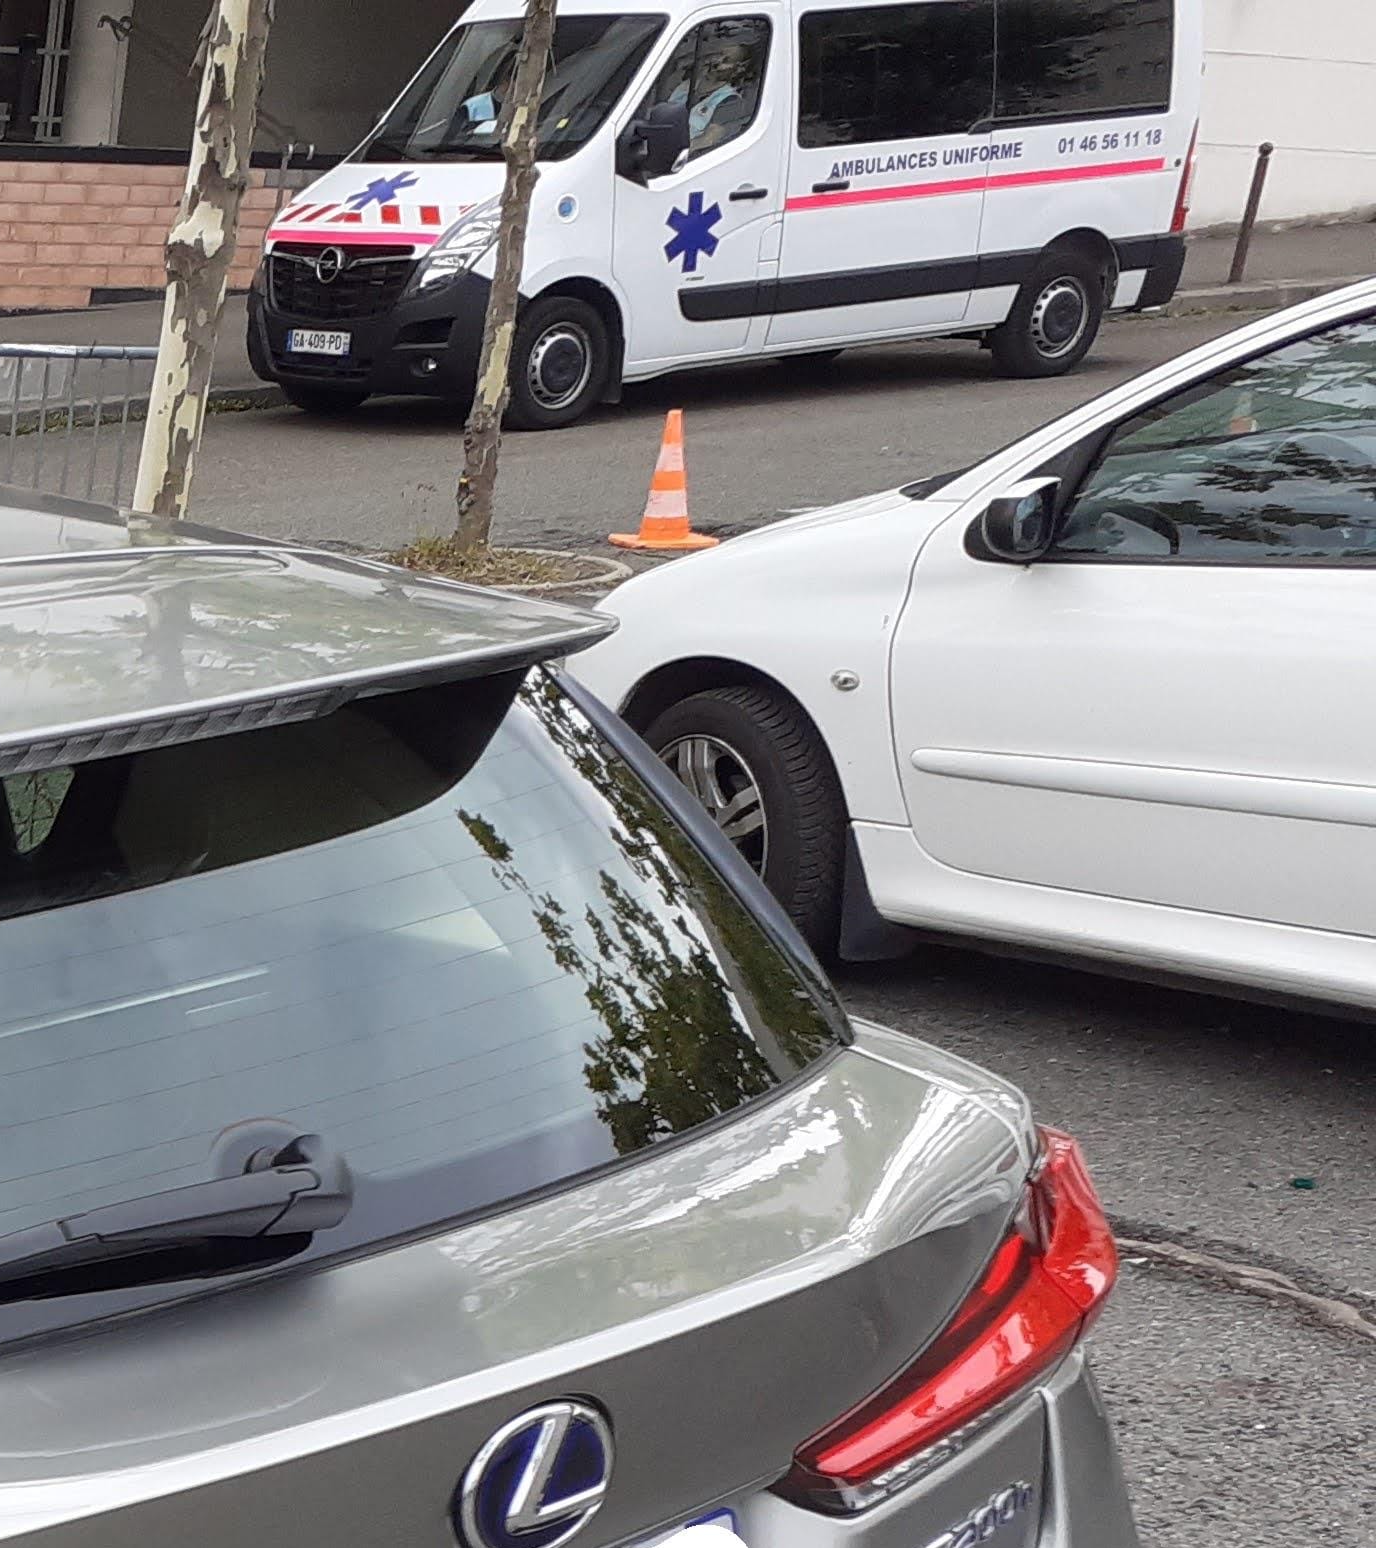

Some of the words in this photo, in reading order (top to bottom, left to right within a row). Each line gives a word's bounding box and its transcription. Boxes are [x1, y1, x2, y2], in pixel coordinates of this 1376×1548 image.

[1058, 137, 1075, 154] 01
[1079, 135, 1098, 152] 46
[1101, 132, 1119, 150] 56
[1124, 131, 1140, 148] 11
[1145, 128, 1162, 146] 18
[829, 150, 938, 179] AMBULANCES
[943, 141, 1023, 166] UNIFORME
